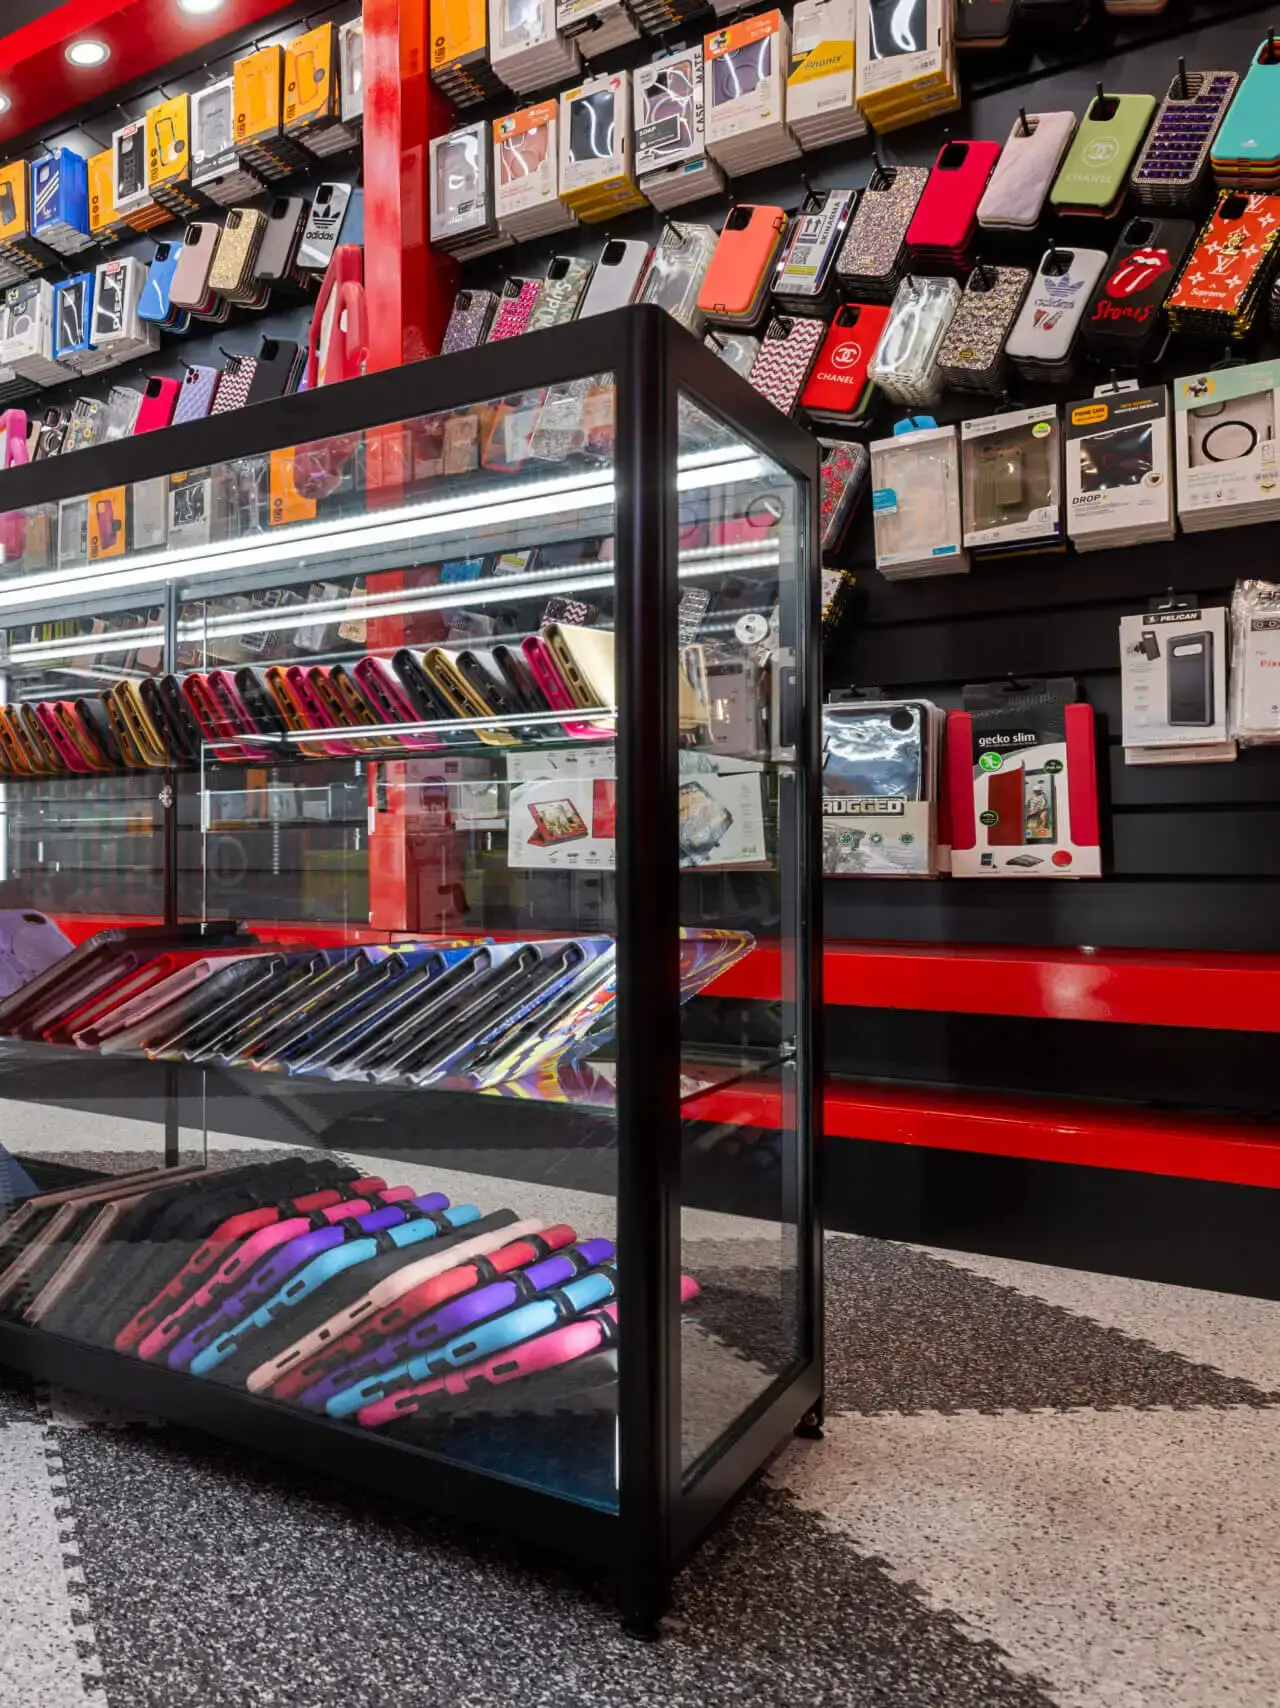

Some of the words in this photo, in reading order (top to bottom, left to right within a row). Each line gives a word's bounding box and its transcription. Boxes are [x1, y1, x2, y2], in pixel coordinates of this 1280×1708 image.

[305, 230, 335, 241] adidas
[816, 371, 855, 385] CHANEL
[1160, 612, 1198, 622] PELICAN
[979, 733, 1010, 747] gecko
[1012, 732, 1035, 743] slim
[822, 799, 903, 814] RUGGED
